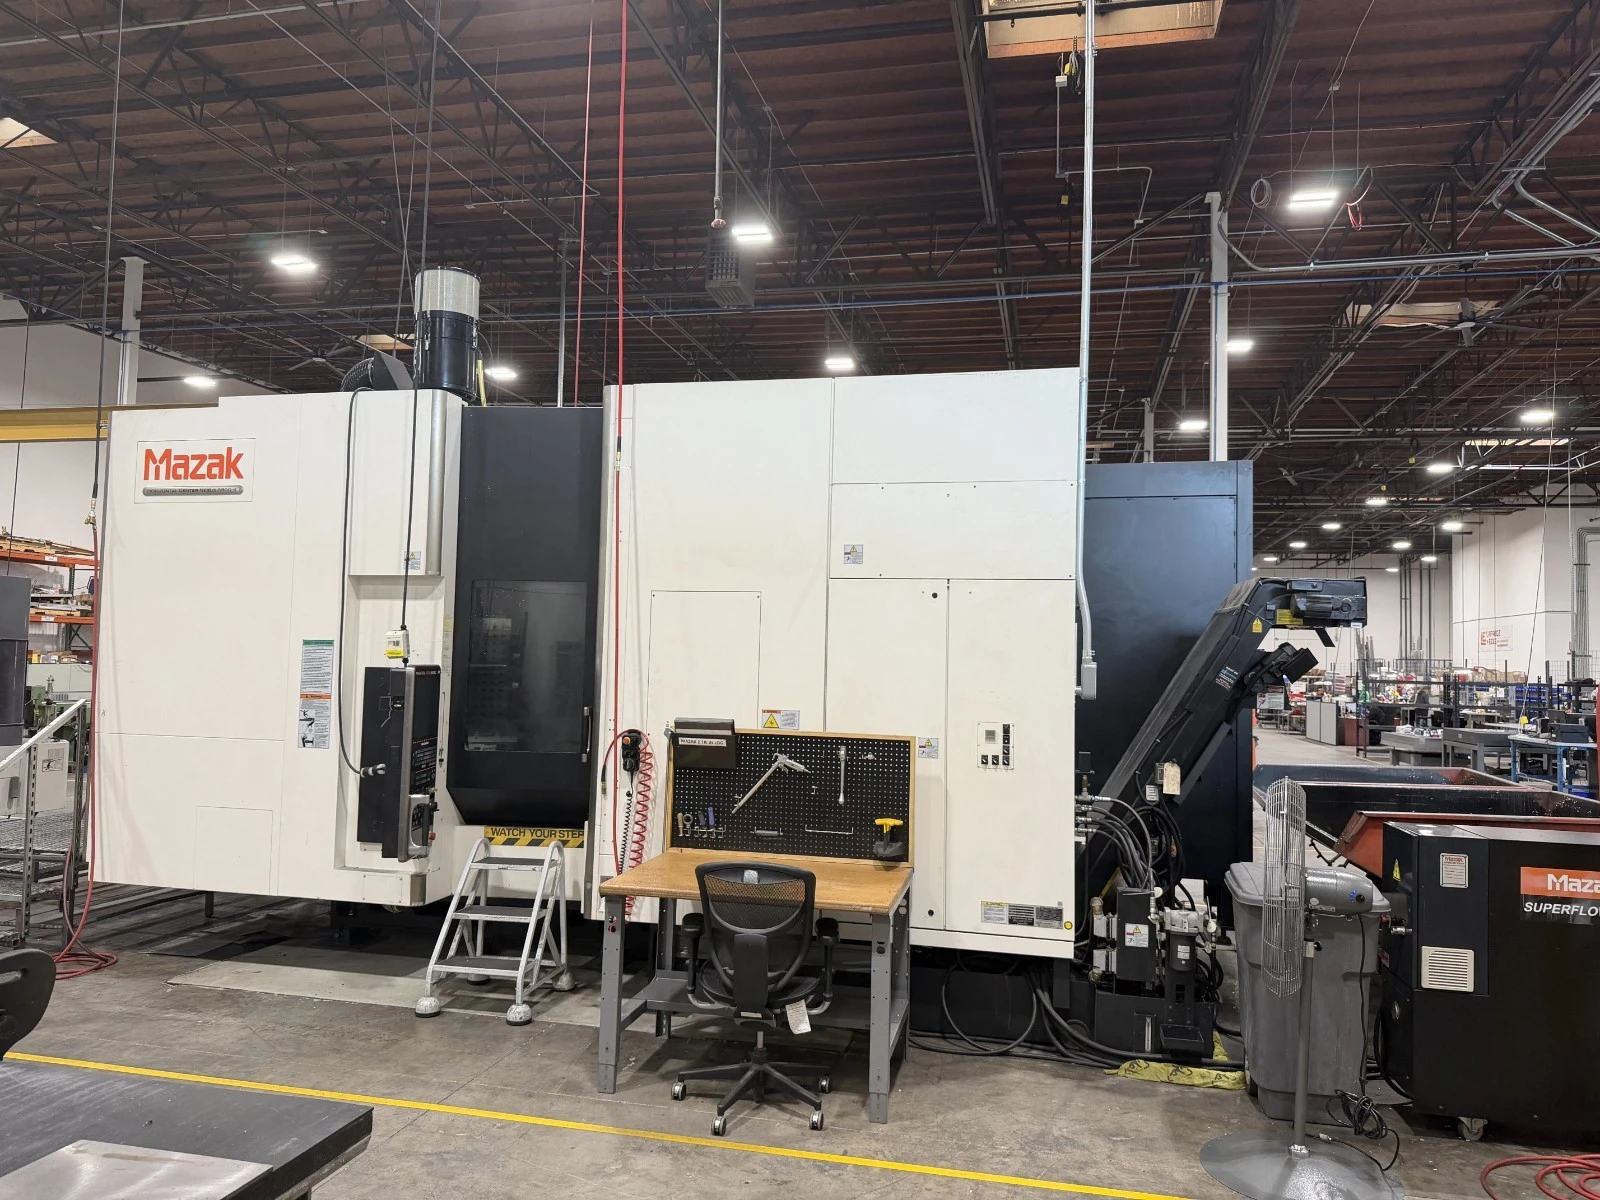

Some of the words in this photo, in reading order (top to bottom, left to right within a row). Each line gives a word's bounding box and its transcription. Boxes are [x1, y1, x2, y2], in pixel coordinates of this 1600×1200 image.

[143, 447, 244, 480] Mazak
[491, 827, 526, 837] WATCH
[528, 828, 556, 838] YOUR
[558, 830, 584, 838] STEP
[1524, 902, 1600, 917] SUPERFLO
